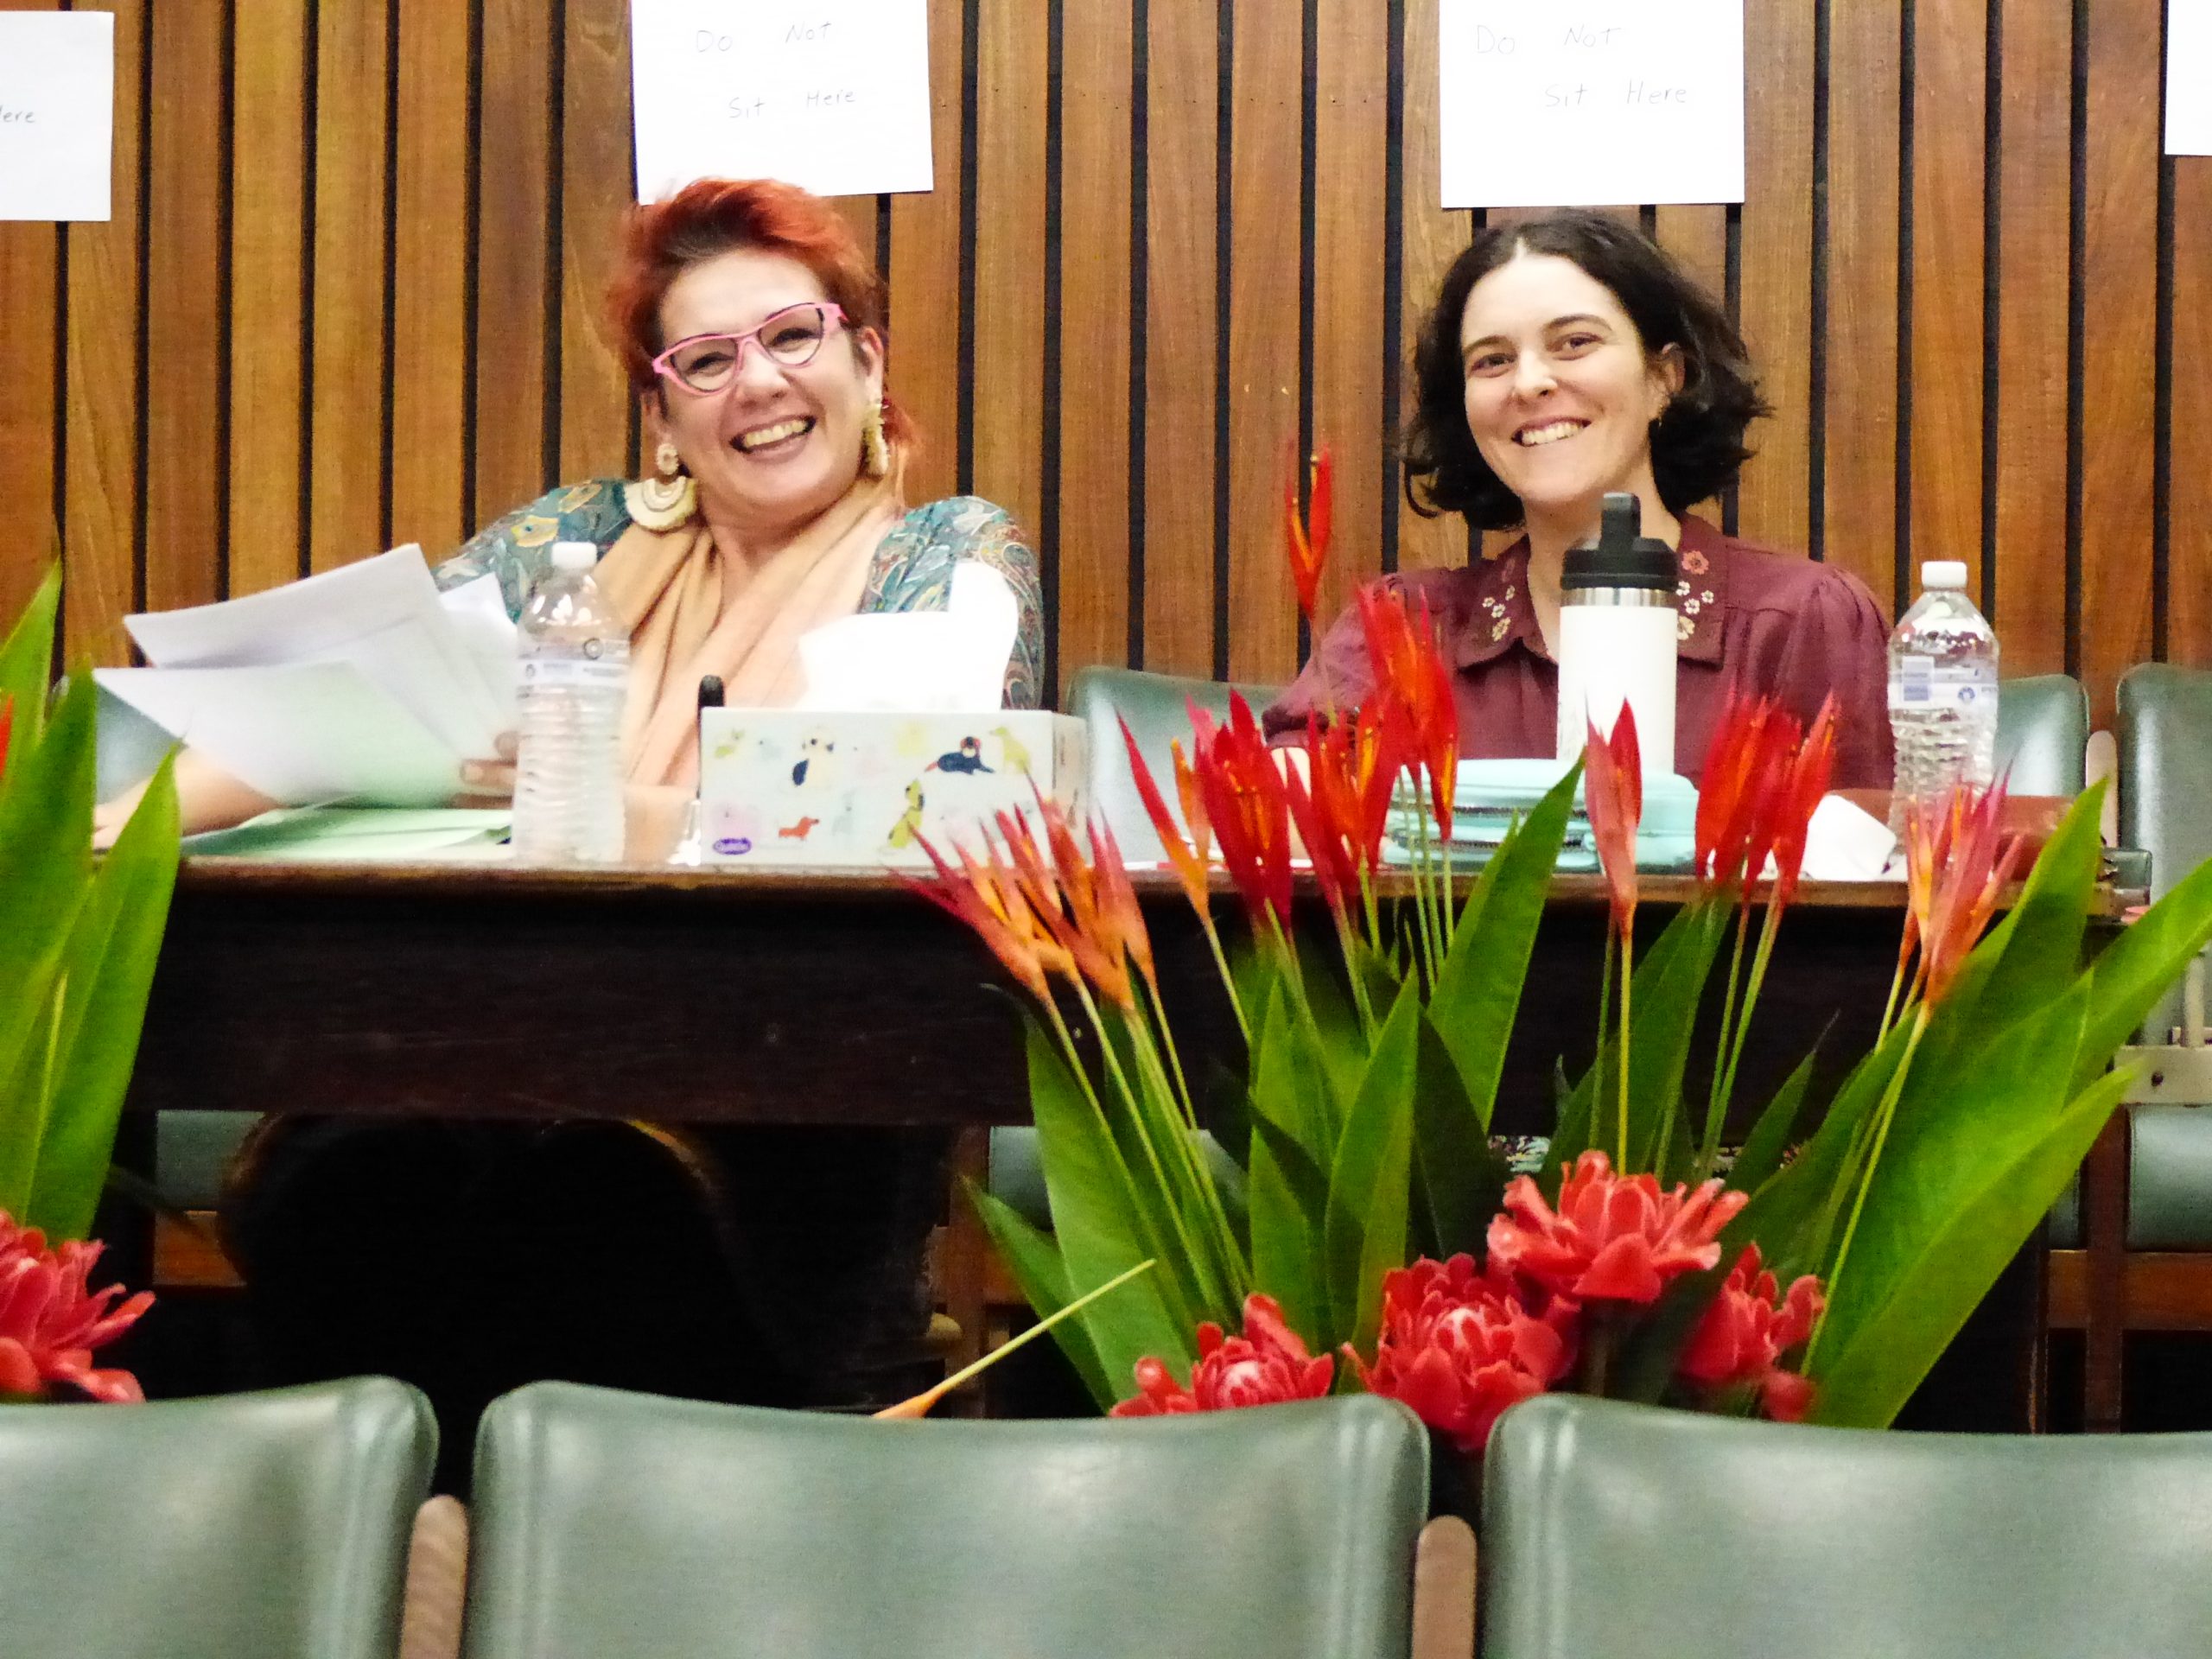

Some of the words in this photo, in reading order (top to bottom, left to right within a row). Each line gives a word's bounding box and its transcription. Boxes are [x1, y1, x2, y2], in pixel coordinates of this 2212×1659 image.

[696, 29, 733, 53] Do
[1476, 24, 1516, 54] Do
[728, 96, 766, 118] Sit
[805, 89, 856, 109] Here
[1544, 82, 1589, 107] Sit
[1625, 78, 1688, 104] Here
